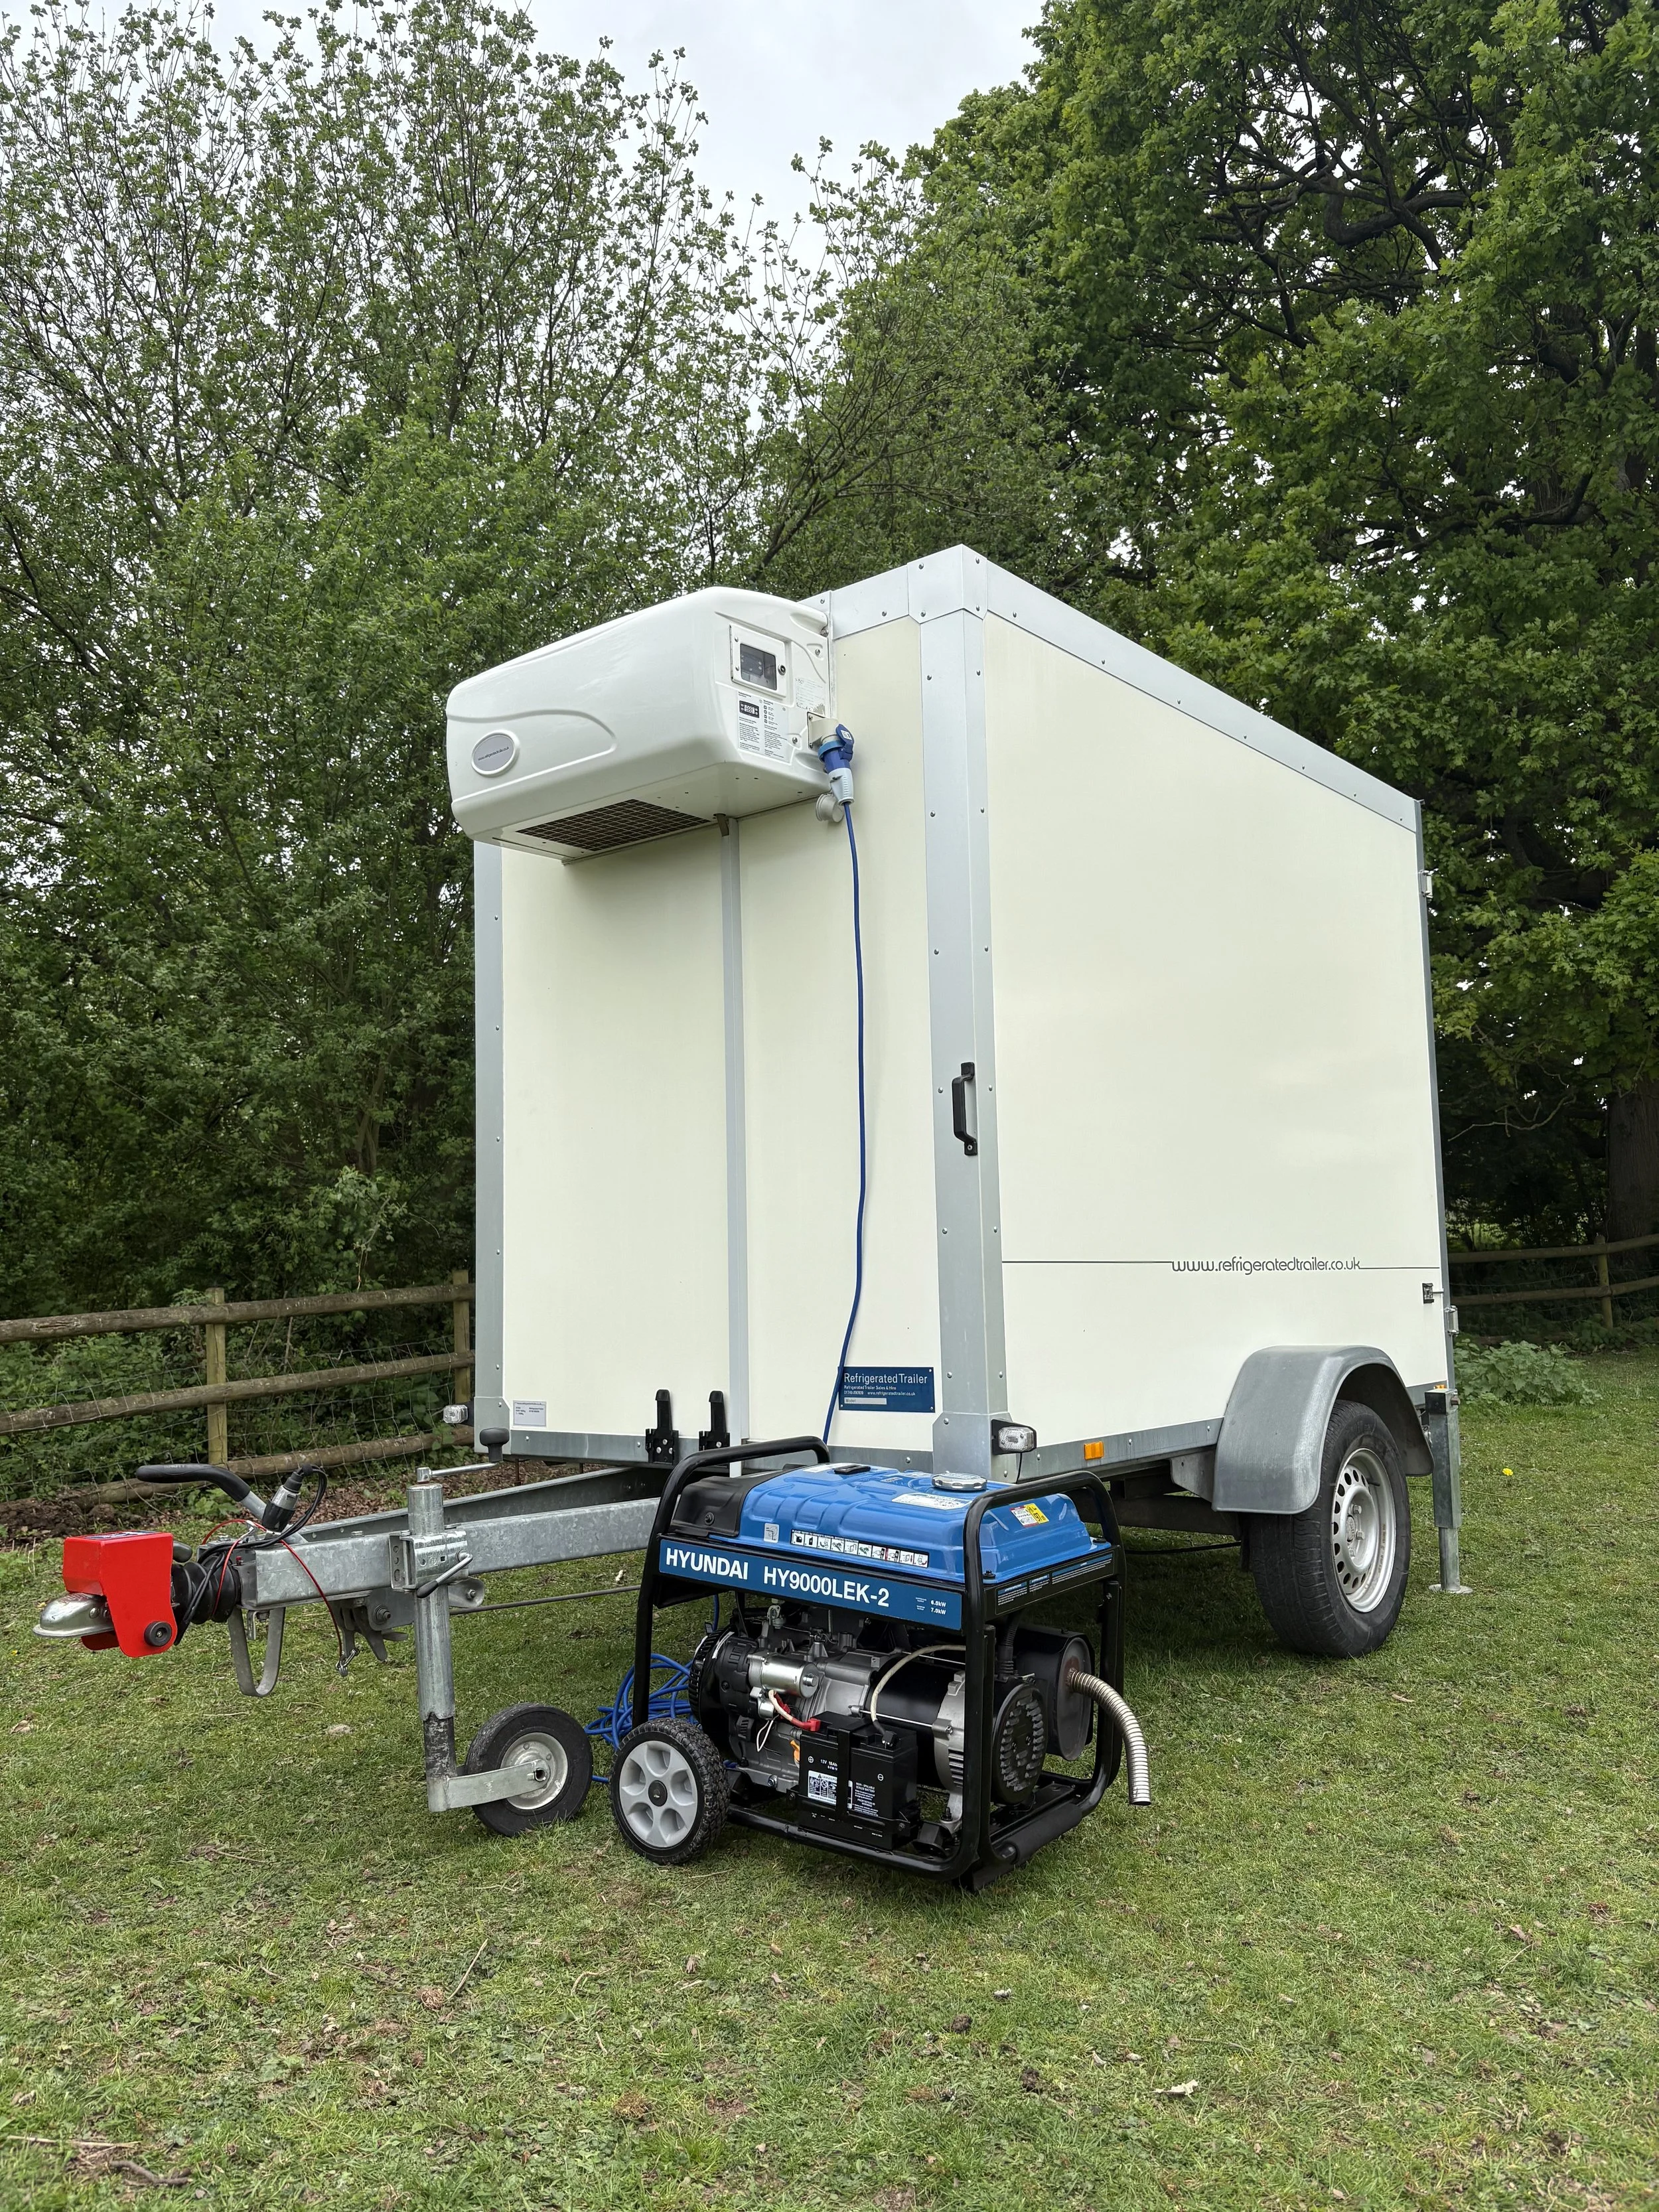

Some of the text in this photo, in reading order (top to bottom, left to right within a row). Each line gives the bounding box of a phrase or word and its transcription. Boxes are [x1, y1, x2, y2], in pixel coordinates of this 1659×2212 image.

[1172, 1256, 1360, 1275] www.refrigeratedtrailer.co.uk
[844, 1372, 928, 1384] Refrigerated Trailer
[667, 1548, 889, 1607] HYUNDAI HY9000LEK-2
